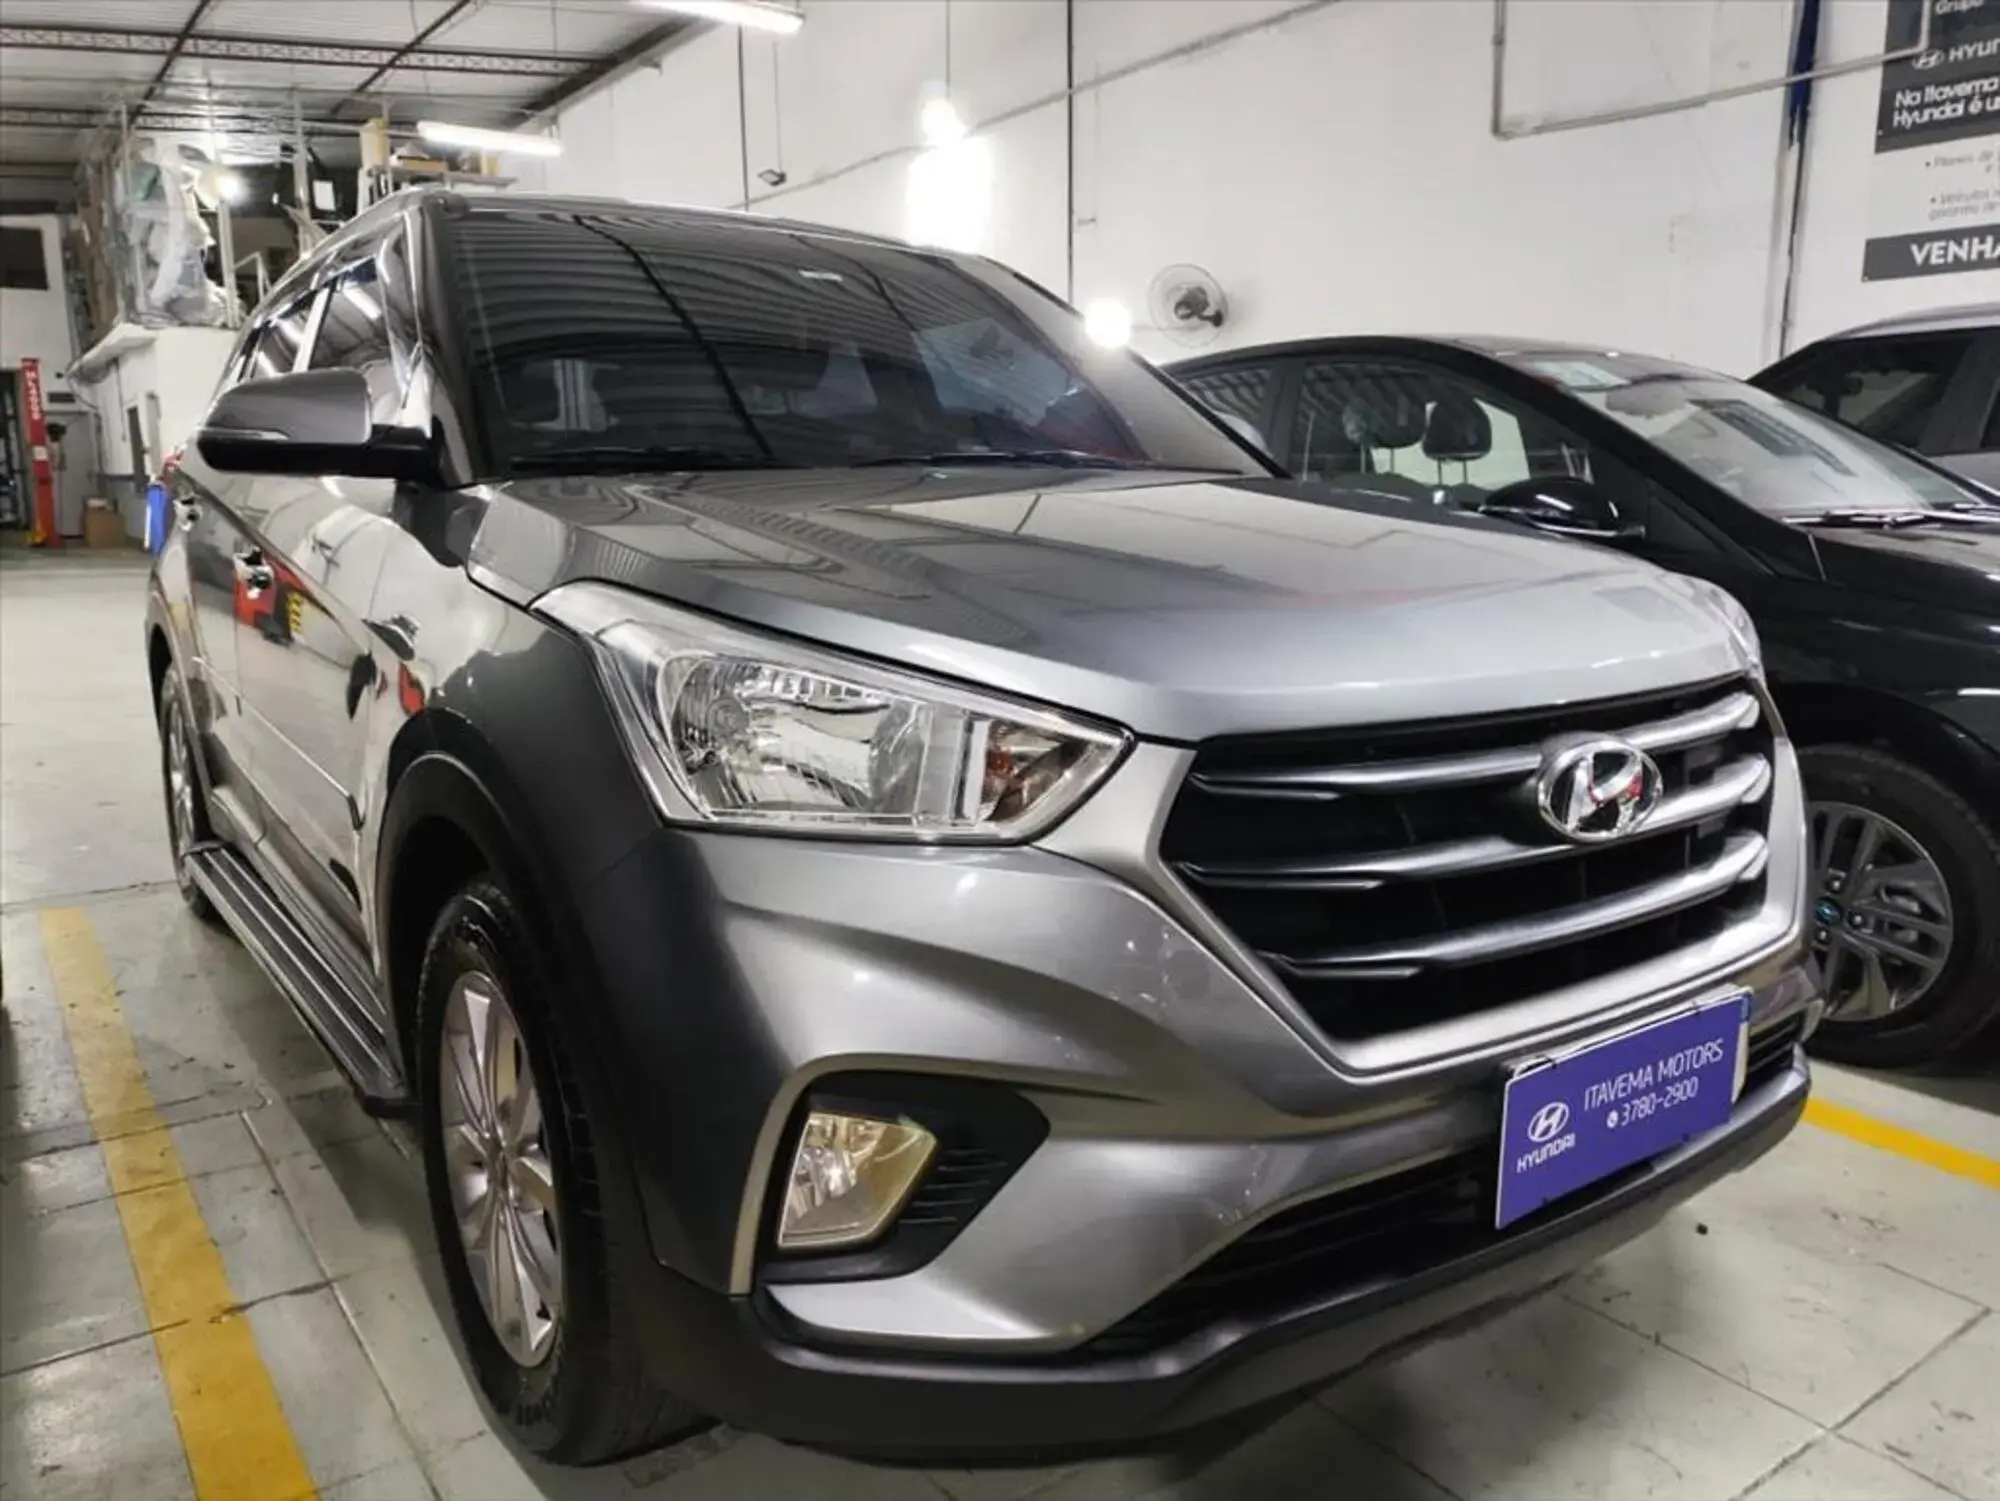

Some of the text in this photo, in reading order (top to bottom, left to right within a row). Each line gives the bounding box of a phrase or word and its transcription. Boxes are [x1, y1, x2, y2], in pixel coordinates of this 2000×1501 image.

[1893, 98, 1965, 130] Hyundai
[1968, 95, 1983, 114] é
[1895, 77, 1999, 108] Na Itavema
[1584, 1037, 1723, 1111] ITAVEMA MOTORS
[1621, 1076, 1698, 1127] 3780-2900
[1517, 1132, 1575, 1173] HYUNDAI
